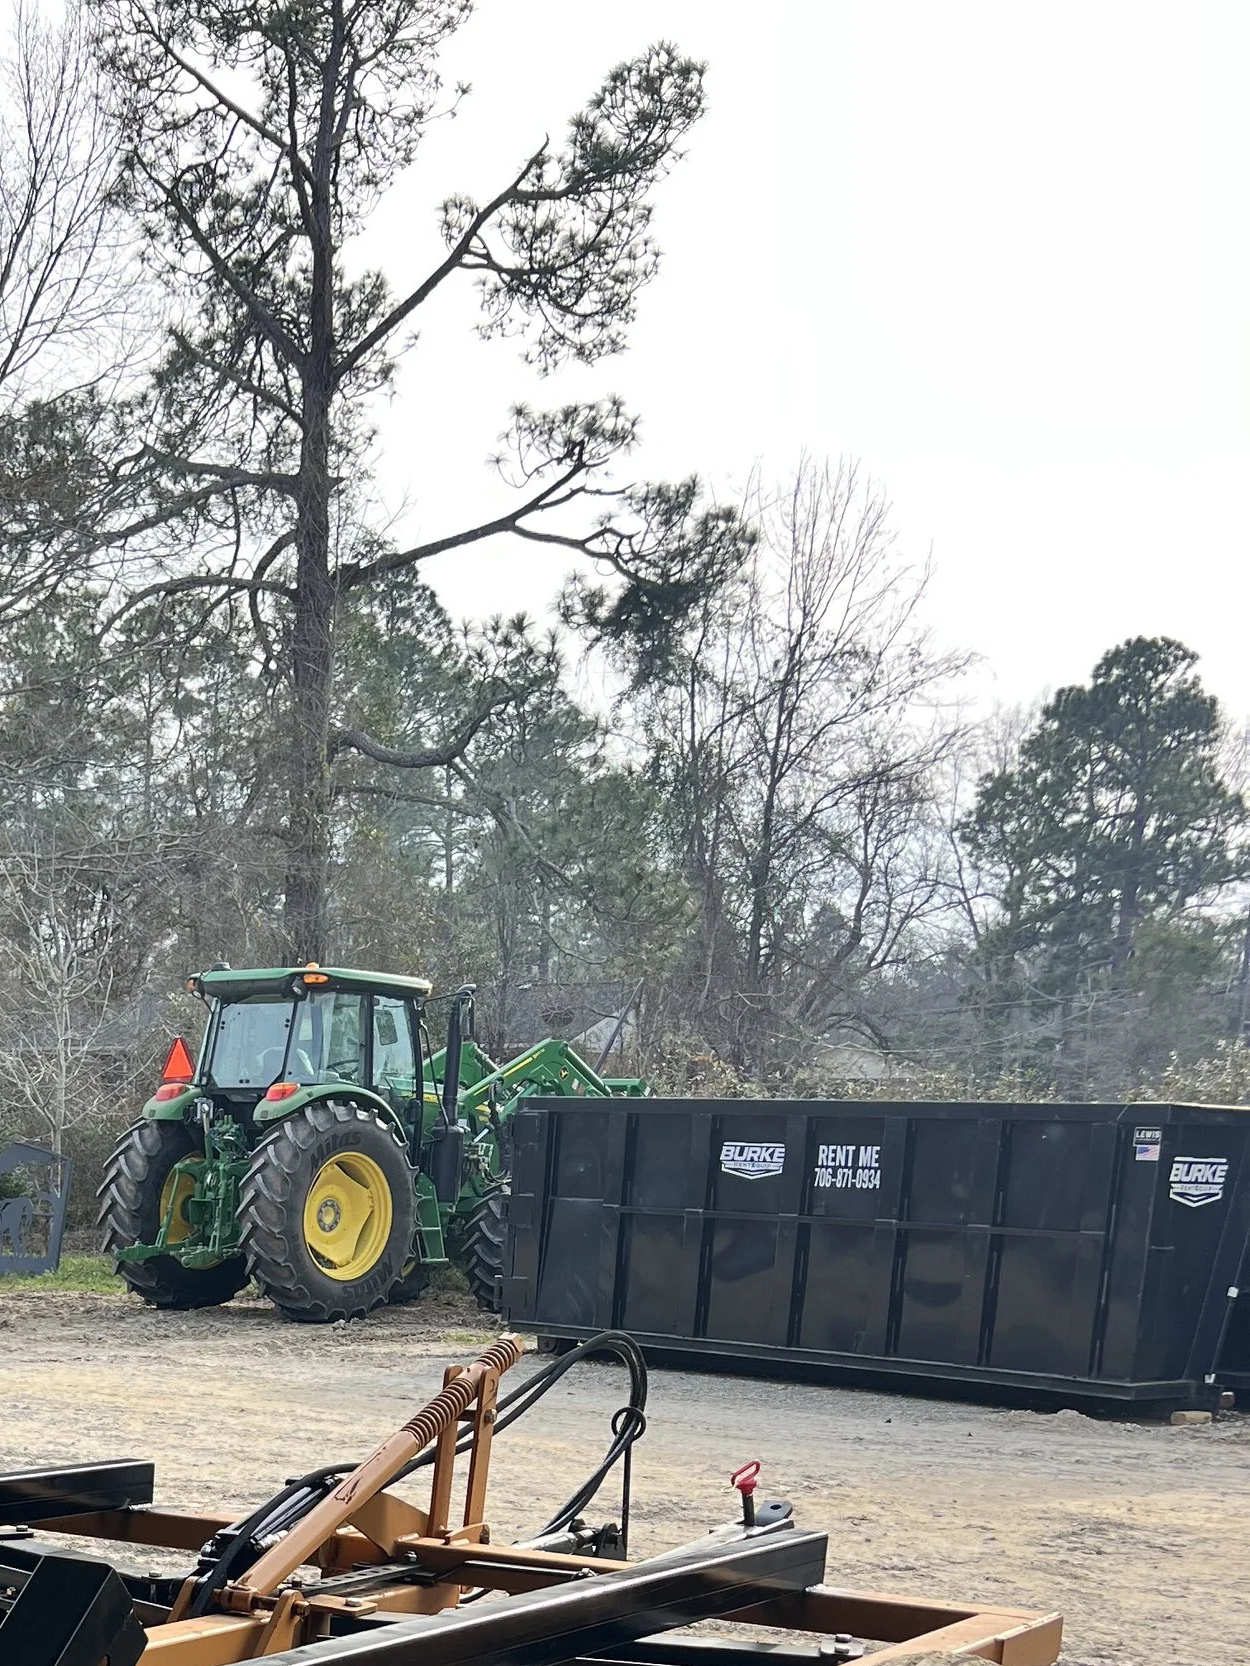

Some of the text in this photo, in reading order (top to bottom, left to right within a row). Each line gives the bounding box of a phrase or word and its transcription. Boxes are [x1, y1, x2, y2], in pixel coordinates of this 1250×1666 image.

[1136, 1130, 1161, 1139] LEWIS
[720, 1146, 785, 1162] BURKE
[818, 1145, 881, 1168] RENT ME
[814, 1168, 881, 1189] 706-871-0934
[1169, 1163, 1229, 1183] BURKE
